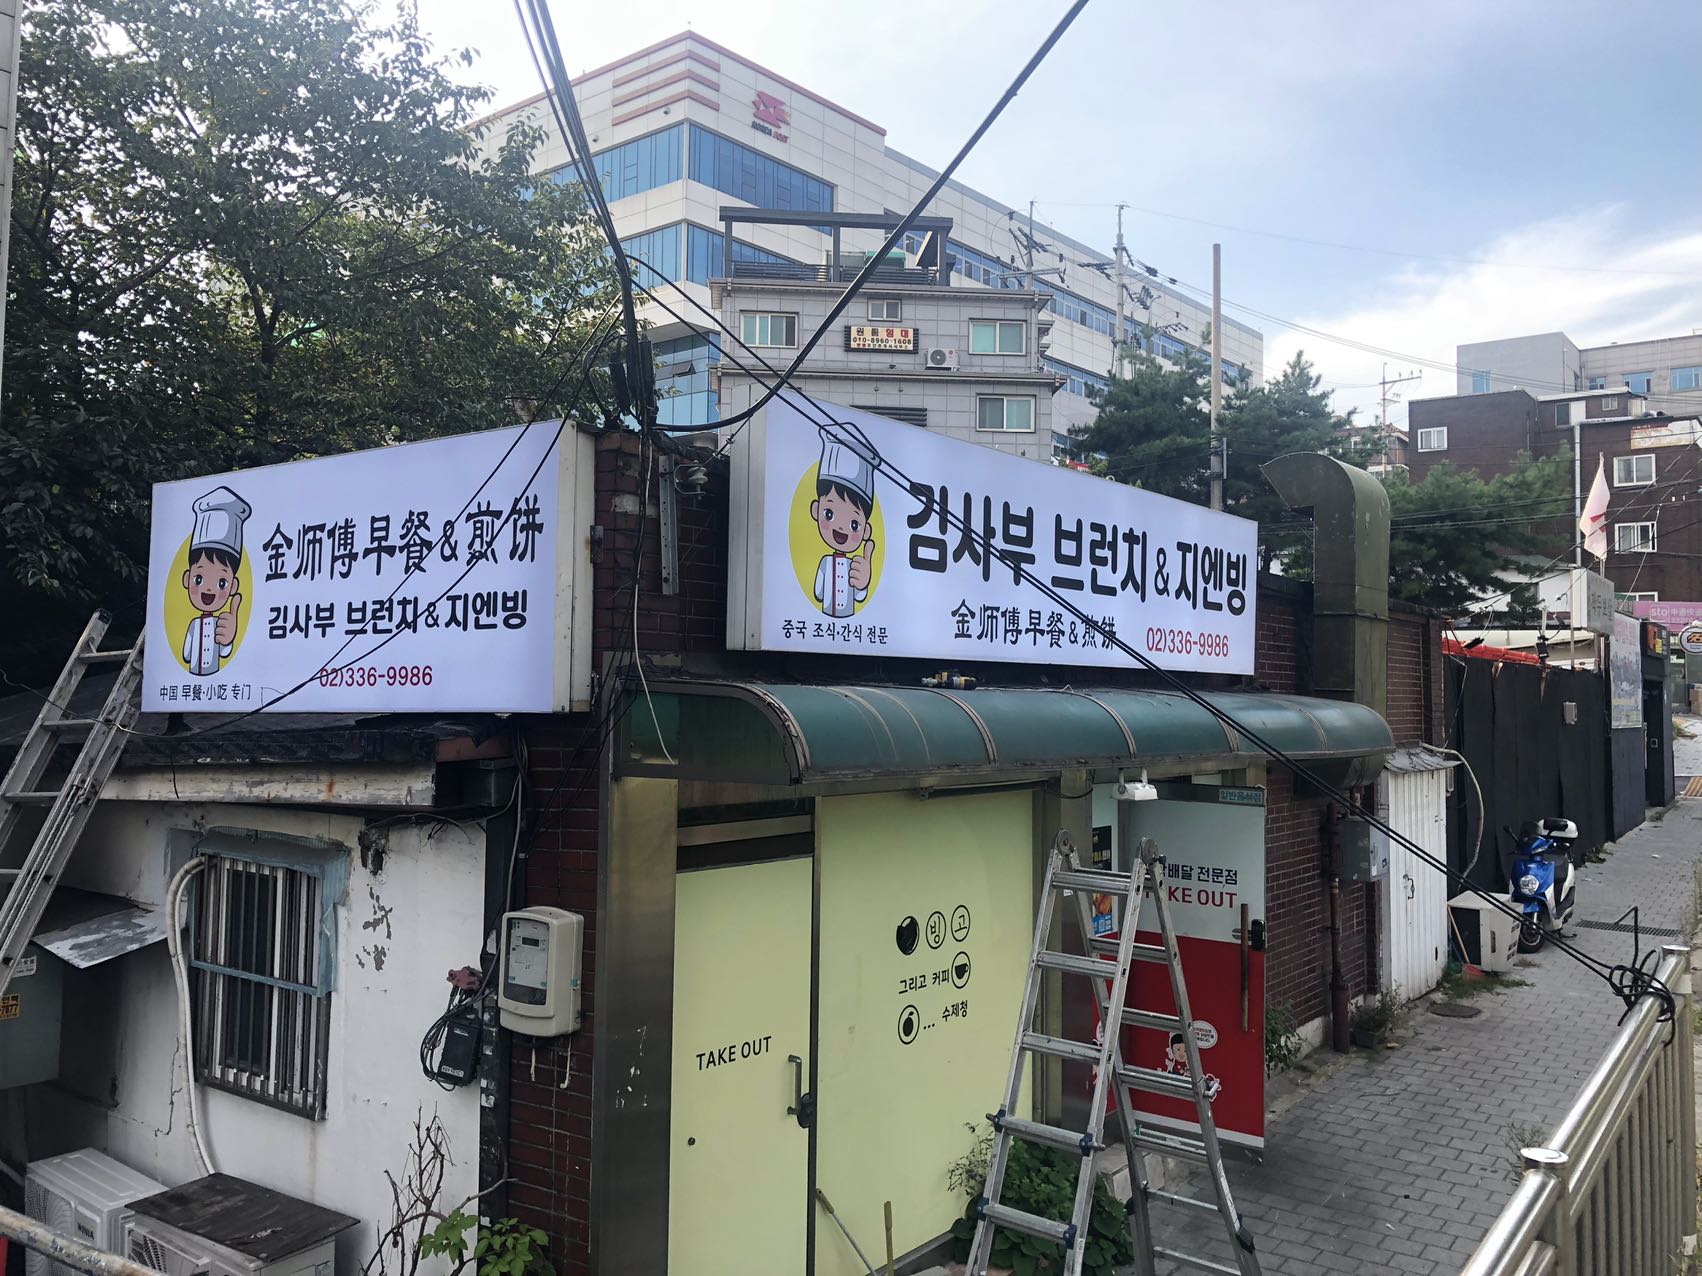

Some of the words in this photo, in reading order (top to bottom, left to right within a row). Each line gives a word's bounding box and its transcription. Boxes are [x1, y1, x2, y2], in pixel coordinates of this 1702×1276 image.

[907, 481, 1036, 587] 김사부
[268, 602, 336, 639] 김사부
[344, 589, 528, 635] 브런치&지엔빙
[782, 619, 808, 639] 중국
[812, 622, 862, 643] 조식·간식
[866, 625, 889, 645] 전문
[1146, 626, 1229, 657] 02)336-9986
[319, 665, 433, 688] 02)336-9986
[160, 684, 179, 701] 中国
[231, 683, 251, 701] 专门
[1197, 866, 1238, 885] 전문점
[1197, 889, 1238, 909] OUT
[898, 974, 927, 994] 그리고
[932, 968, 950, 986] 커피
[941, 999, 968, 1022] 수제청
[696, 1044, 736, 1071] TAKE
[741, 1036, 772, 1059] OUT
